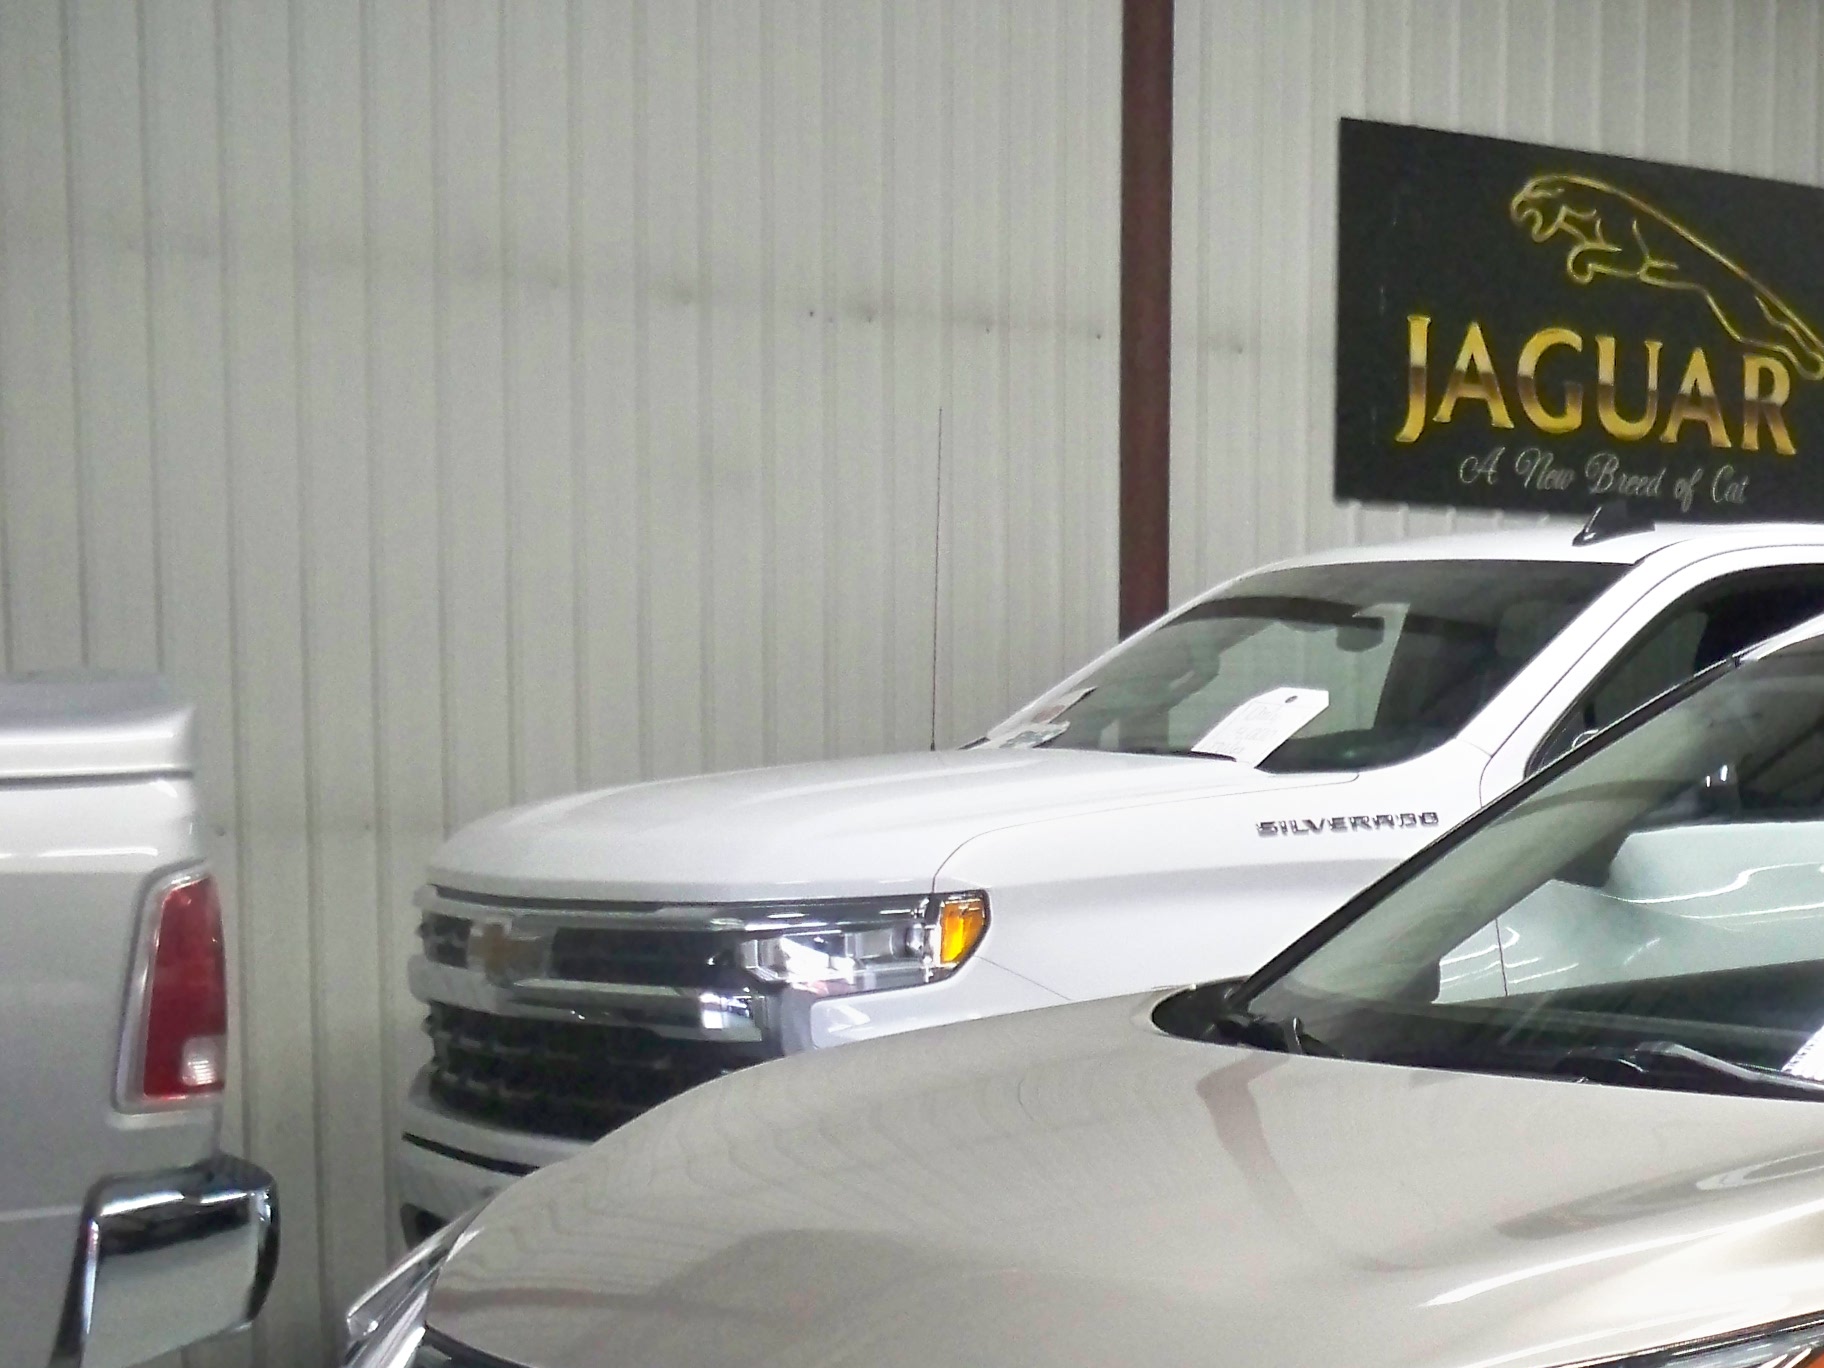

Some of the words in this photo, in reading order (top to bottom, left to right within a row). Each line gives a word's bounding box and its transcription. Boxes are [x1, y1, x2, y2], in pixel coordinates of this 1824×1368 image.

[1394, 314, 1798, 456] JAGUAR
[1458, 446, 1506, 486] A
[1514, 446, 1577, 491] New
[1584, 451, 1667, 497] Breed
[1673, 467, 1704, 513] of
[1711, 464, 1750, 504] Cat
[1255, 811, 1440, 838] SILVERADO
